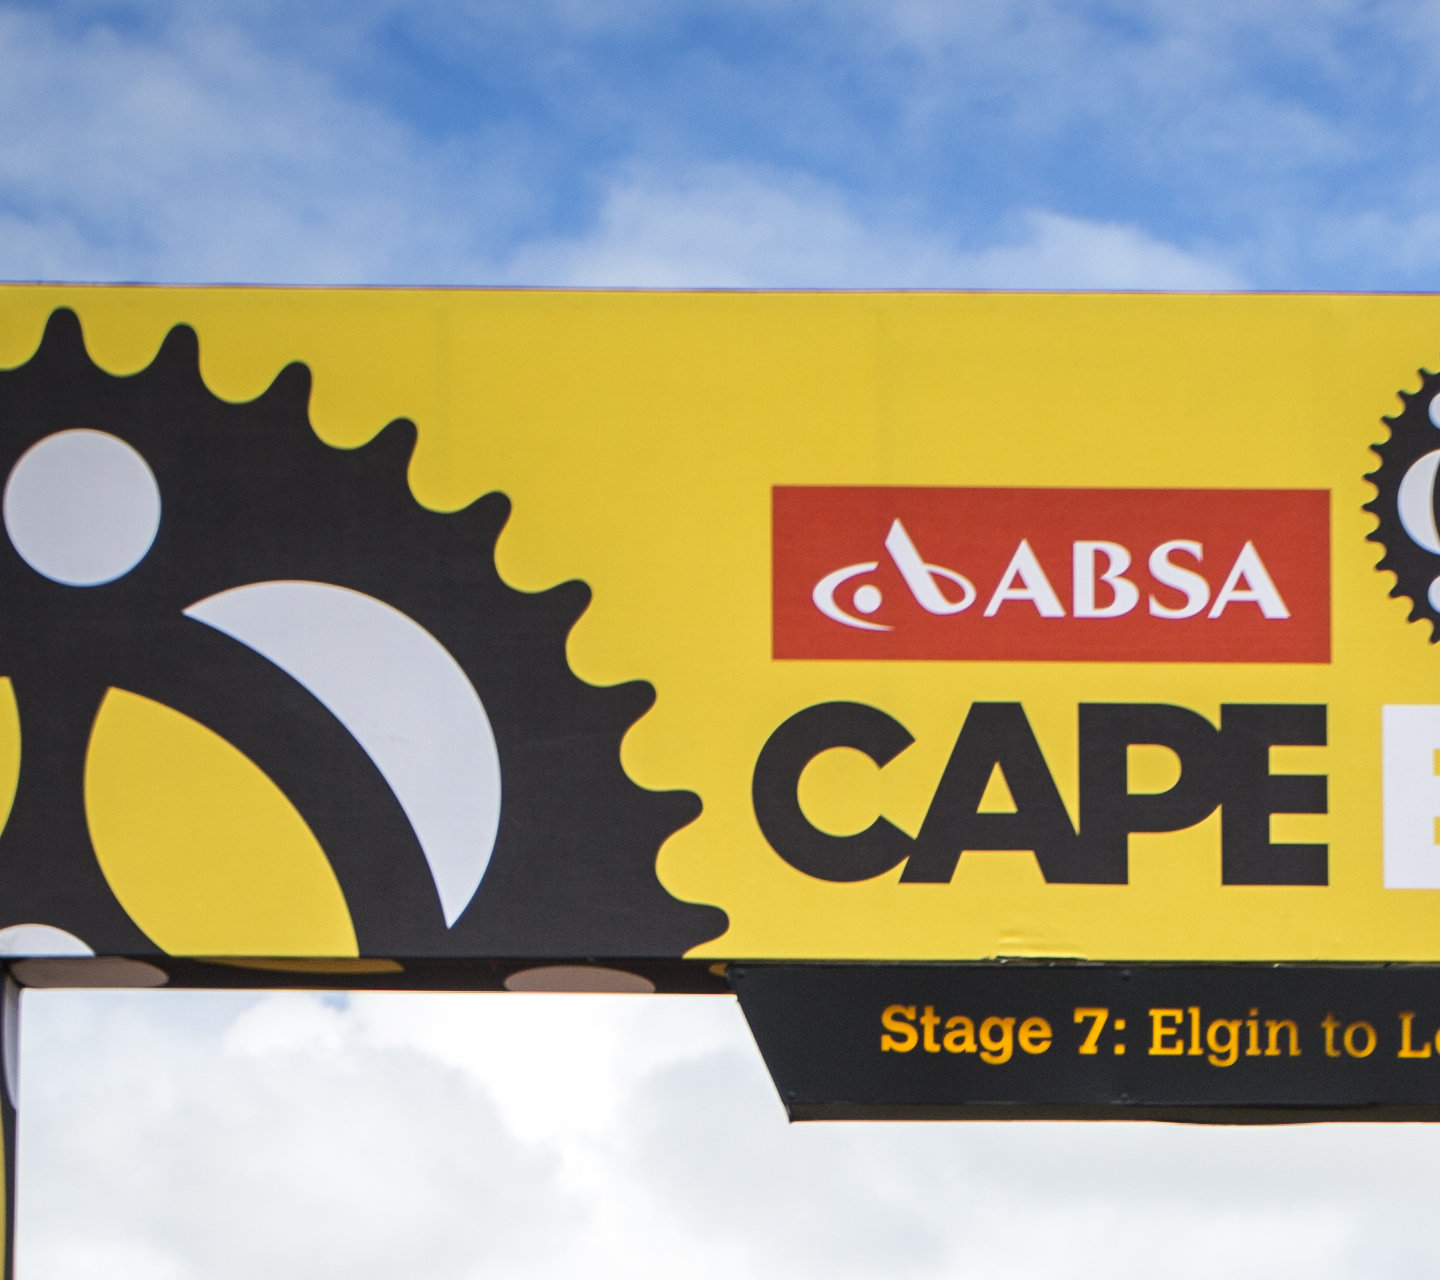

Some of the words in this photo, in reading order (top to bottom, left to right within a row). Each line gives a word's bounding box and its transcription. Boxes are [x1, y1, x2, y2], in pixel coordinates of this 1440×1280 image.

[984, 539, 1290, 620] ABSA
[752, 700, 1329, 886] CAPE
[880, 1004, 1053, 1065] Stage
[1073, 1007, 1127, 1055] 7:
[1147, 1007, 1302, 1067] Elgin
[1321, 1013, 1378, 1059] to
